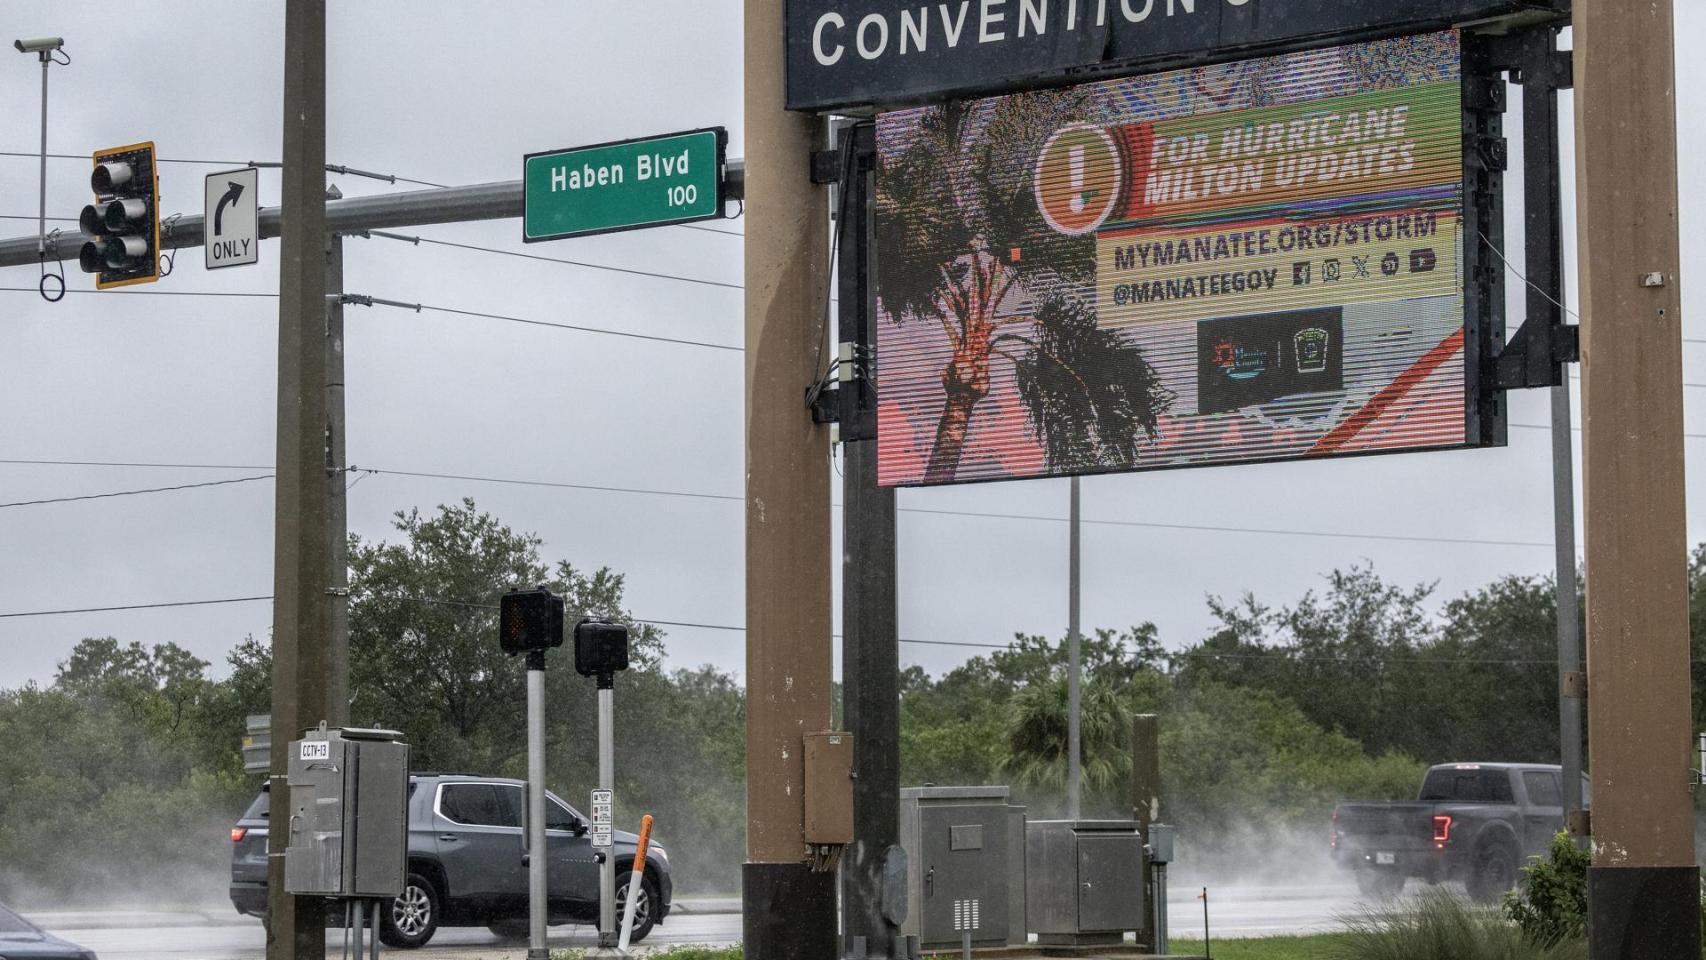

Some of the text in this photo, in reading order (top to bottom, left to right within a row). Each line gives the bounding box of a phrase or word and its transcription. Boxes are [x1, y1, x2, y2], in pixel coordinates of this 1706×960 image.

[1150, 104, 1409, 168] FOR HURRICANE
[551, 149, 689, 193] Haben Blvd
[1144, 142, 1416, 205] MILTON UPDATES
[667, 184, 698, 207] 100
[213, 238, 250, 260] ONLY
[1114, 209, 1437, 271] MYMANATEE.ORG/STORM
[1113, 268, 1278, 306] @MANATEEGOV
[302, 744, 327, 757] CCTV-13
